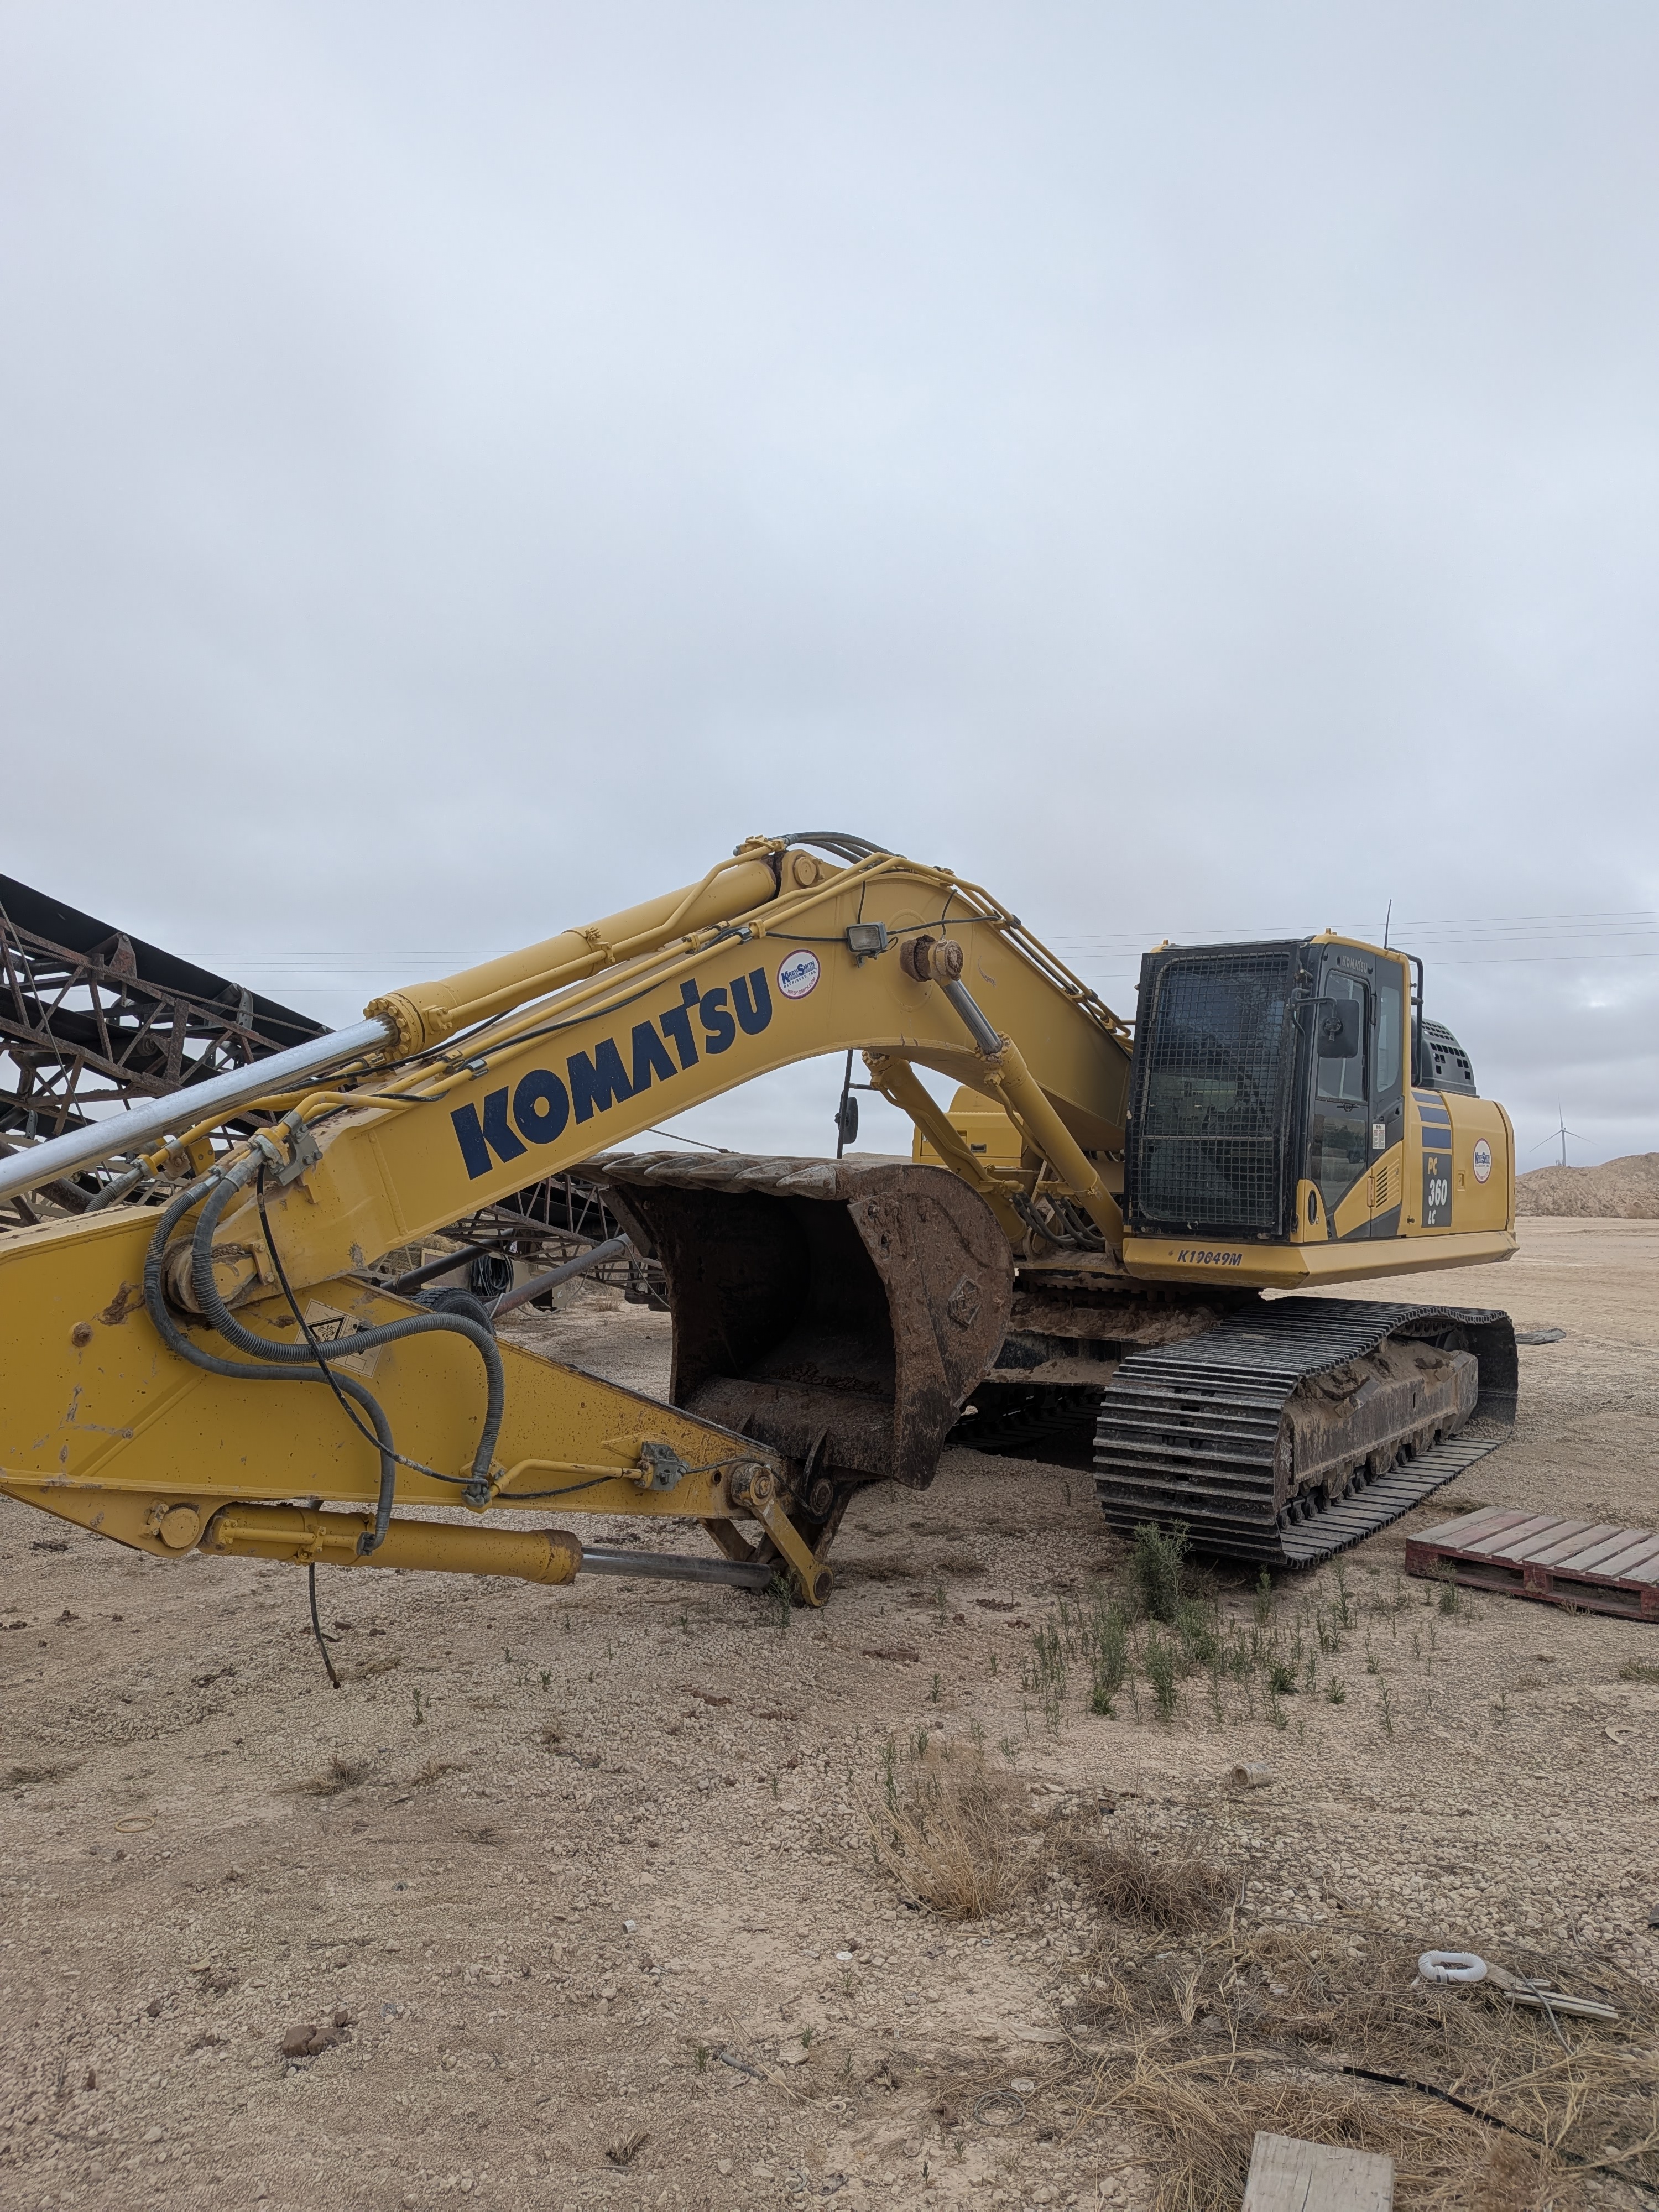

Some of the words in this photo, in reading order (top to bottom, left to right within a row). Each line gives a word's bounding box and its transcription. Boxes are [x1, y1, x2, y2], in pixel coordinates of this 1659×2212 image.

[1342, 955, 1368, 974] KOMATSU
[450, 966, 773, 1181] KOMATSU
[1427, 1157, 1438, 1176] PC
[1428, 1178, 1448, 1206] 360
[1428, 1209, 1436, 1225] LC
